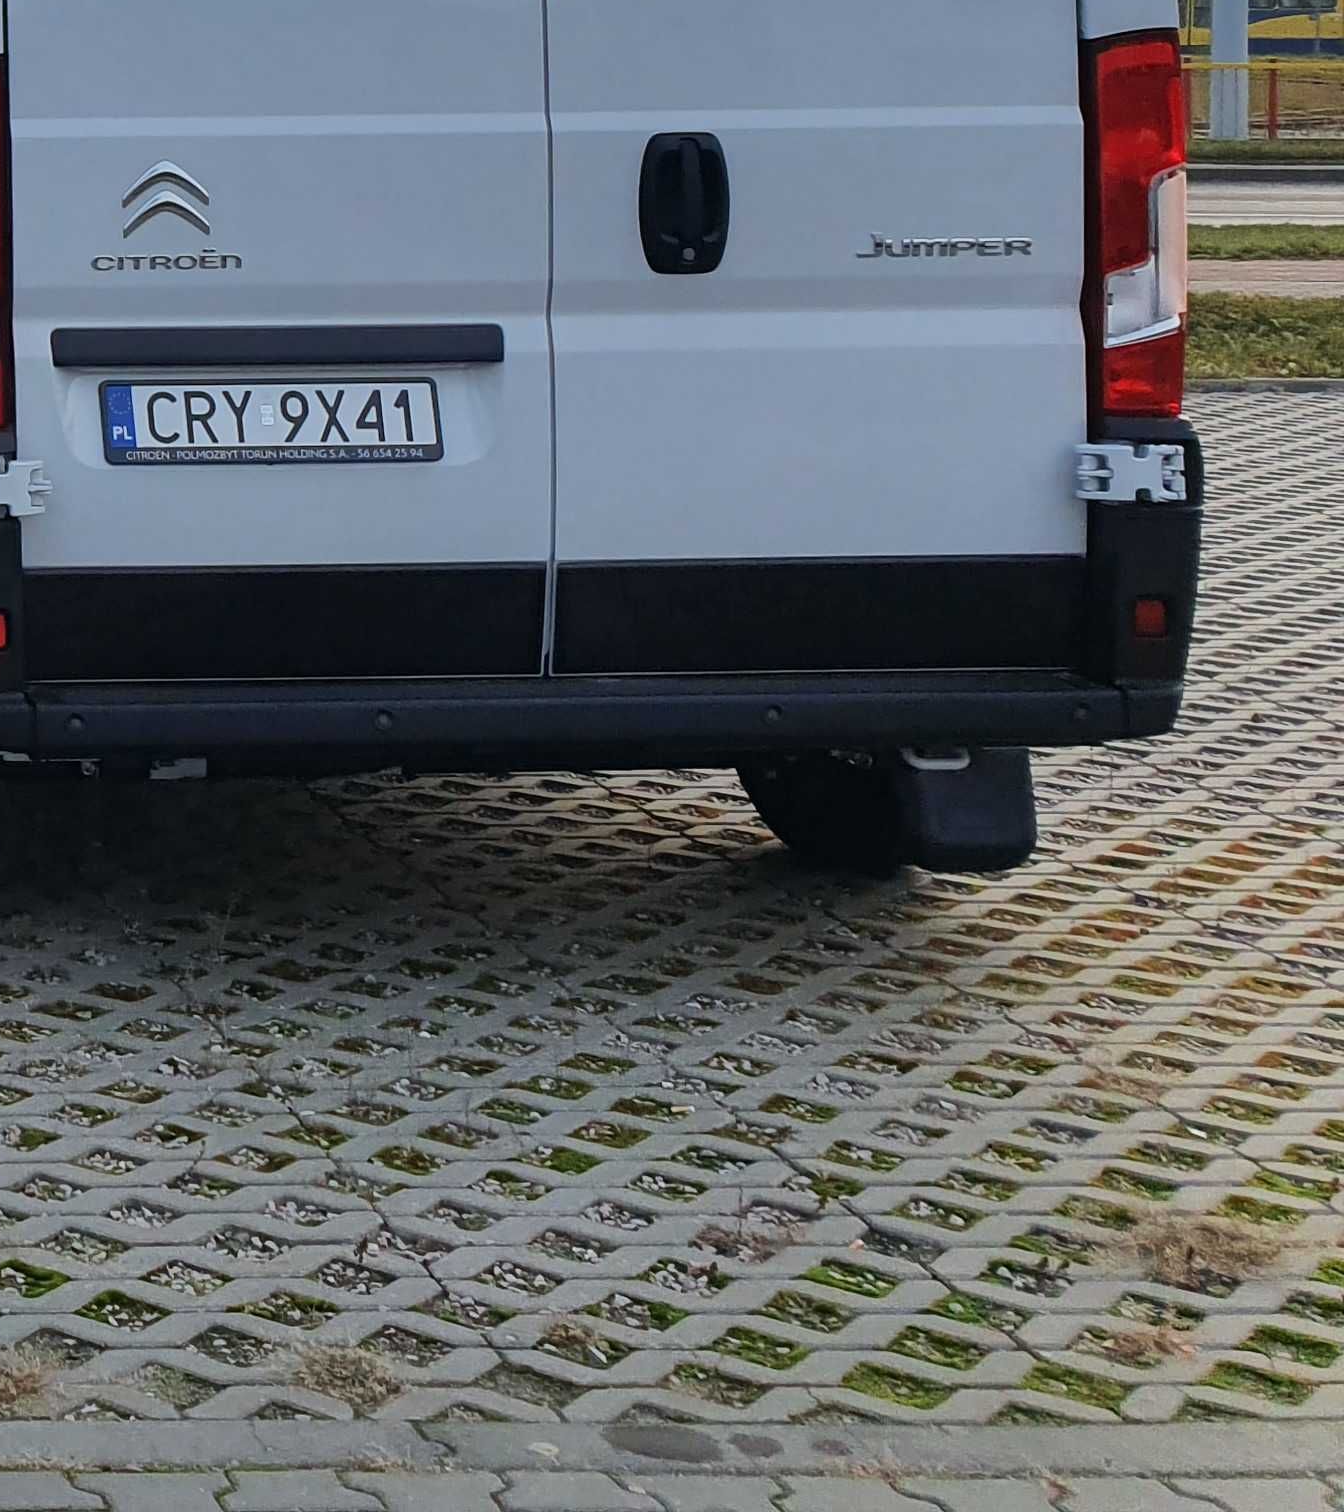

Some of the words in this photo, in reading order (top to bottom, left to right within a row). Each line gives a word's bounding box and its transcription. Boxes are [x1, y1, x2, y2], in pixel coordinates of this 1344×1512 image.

[147, 390, 252, 444] CRY
[280, 389, 415, 443] 9X41
[112, 425, 133, 440] PL
[279, 448, 327, 459] HOLDING
[394, 448, 407, 458] 25
[410, 448, 423, 458] 94
